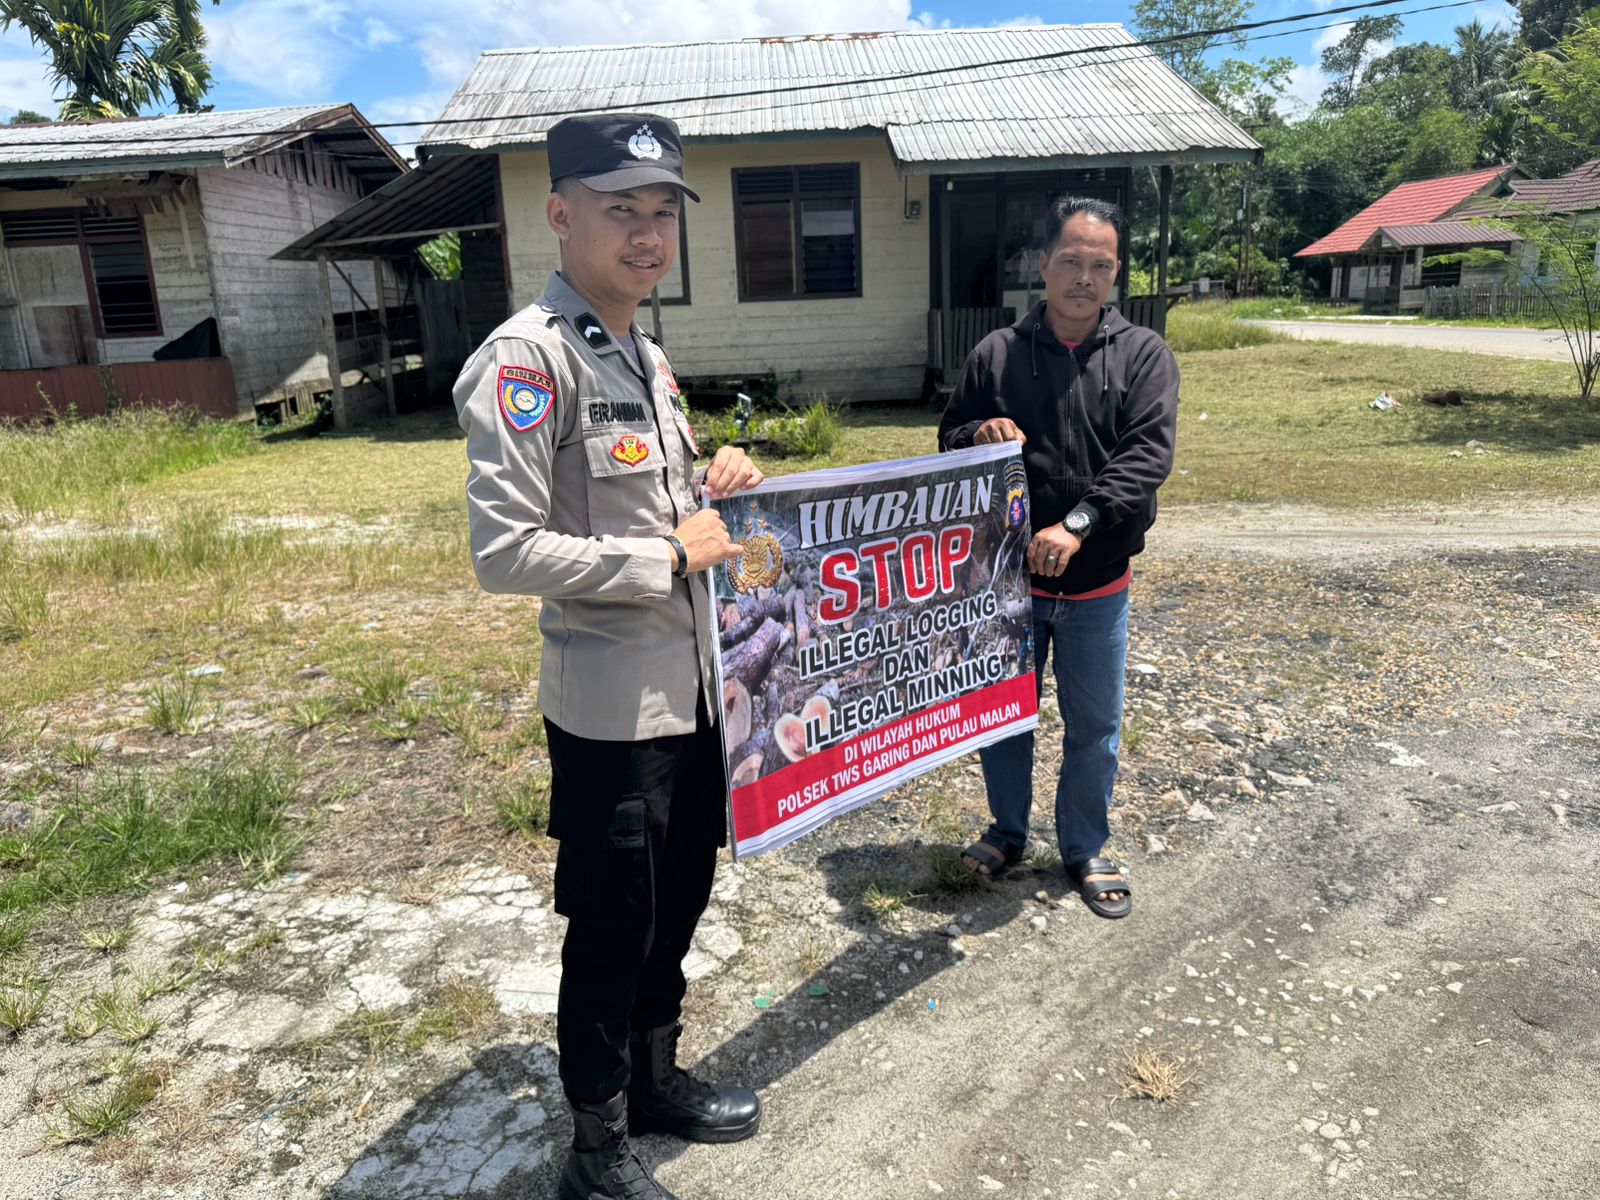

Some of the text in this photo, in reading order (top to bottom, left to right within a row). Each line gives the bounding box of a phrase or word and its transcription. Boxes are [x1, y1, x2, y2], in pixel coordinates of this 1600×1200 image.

[506, 369, 551, 387] BINMAS
[799, 474, 994, 549] HIMBAUAN
[819, 525, 973, 624] STOP
[800, 592, 996, 678] ILLEGAL LOGGING
[884, 643, 930, 684] DAN
[805, 654, 1002, 750] ILLEGAL MINNING
[844, 703, 960, 763] DI WILAYAH HUKUM
[777, 702, 1021, 817] POLSEK TWS GARING DAN PULAU MALAN
